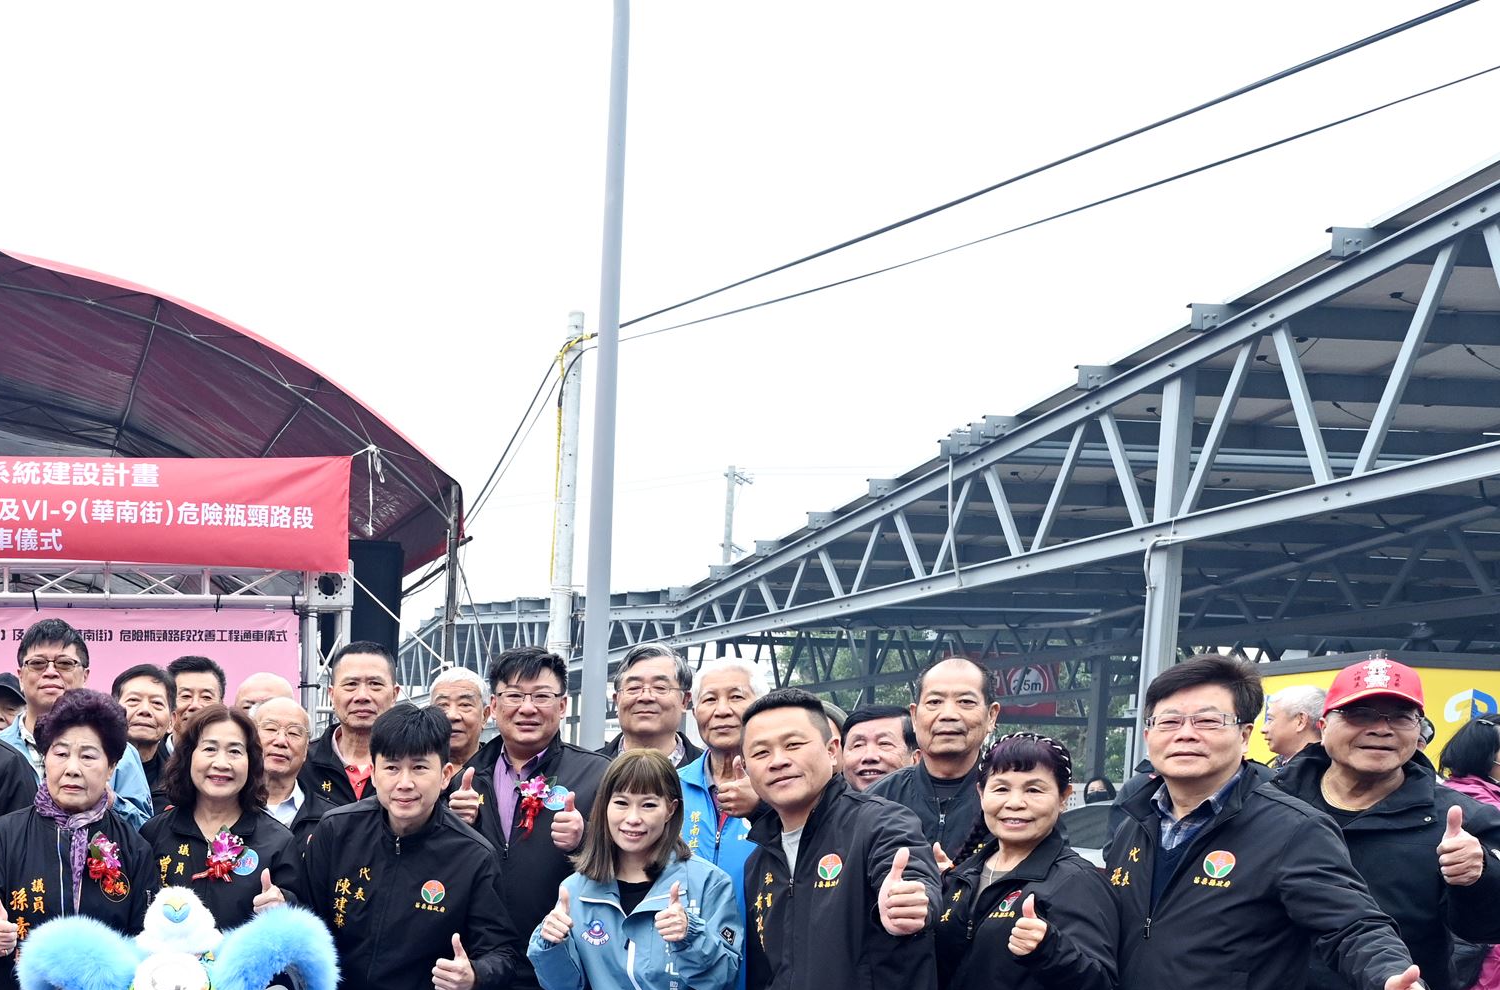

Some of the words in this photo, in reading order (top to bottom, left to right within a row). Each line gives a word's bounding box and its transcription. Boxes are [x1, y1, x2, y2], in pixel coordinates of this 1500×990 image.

[688, 811, 701, 853] 館南社
[174, 844, 190, 875] 議員
[31, 878, 46, 914] 議員
[354, 866, 371, 901] 代表
